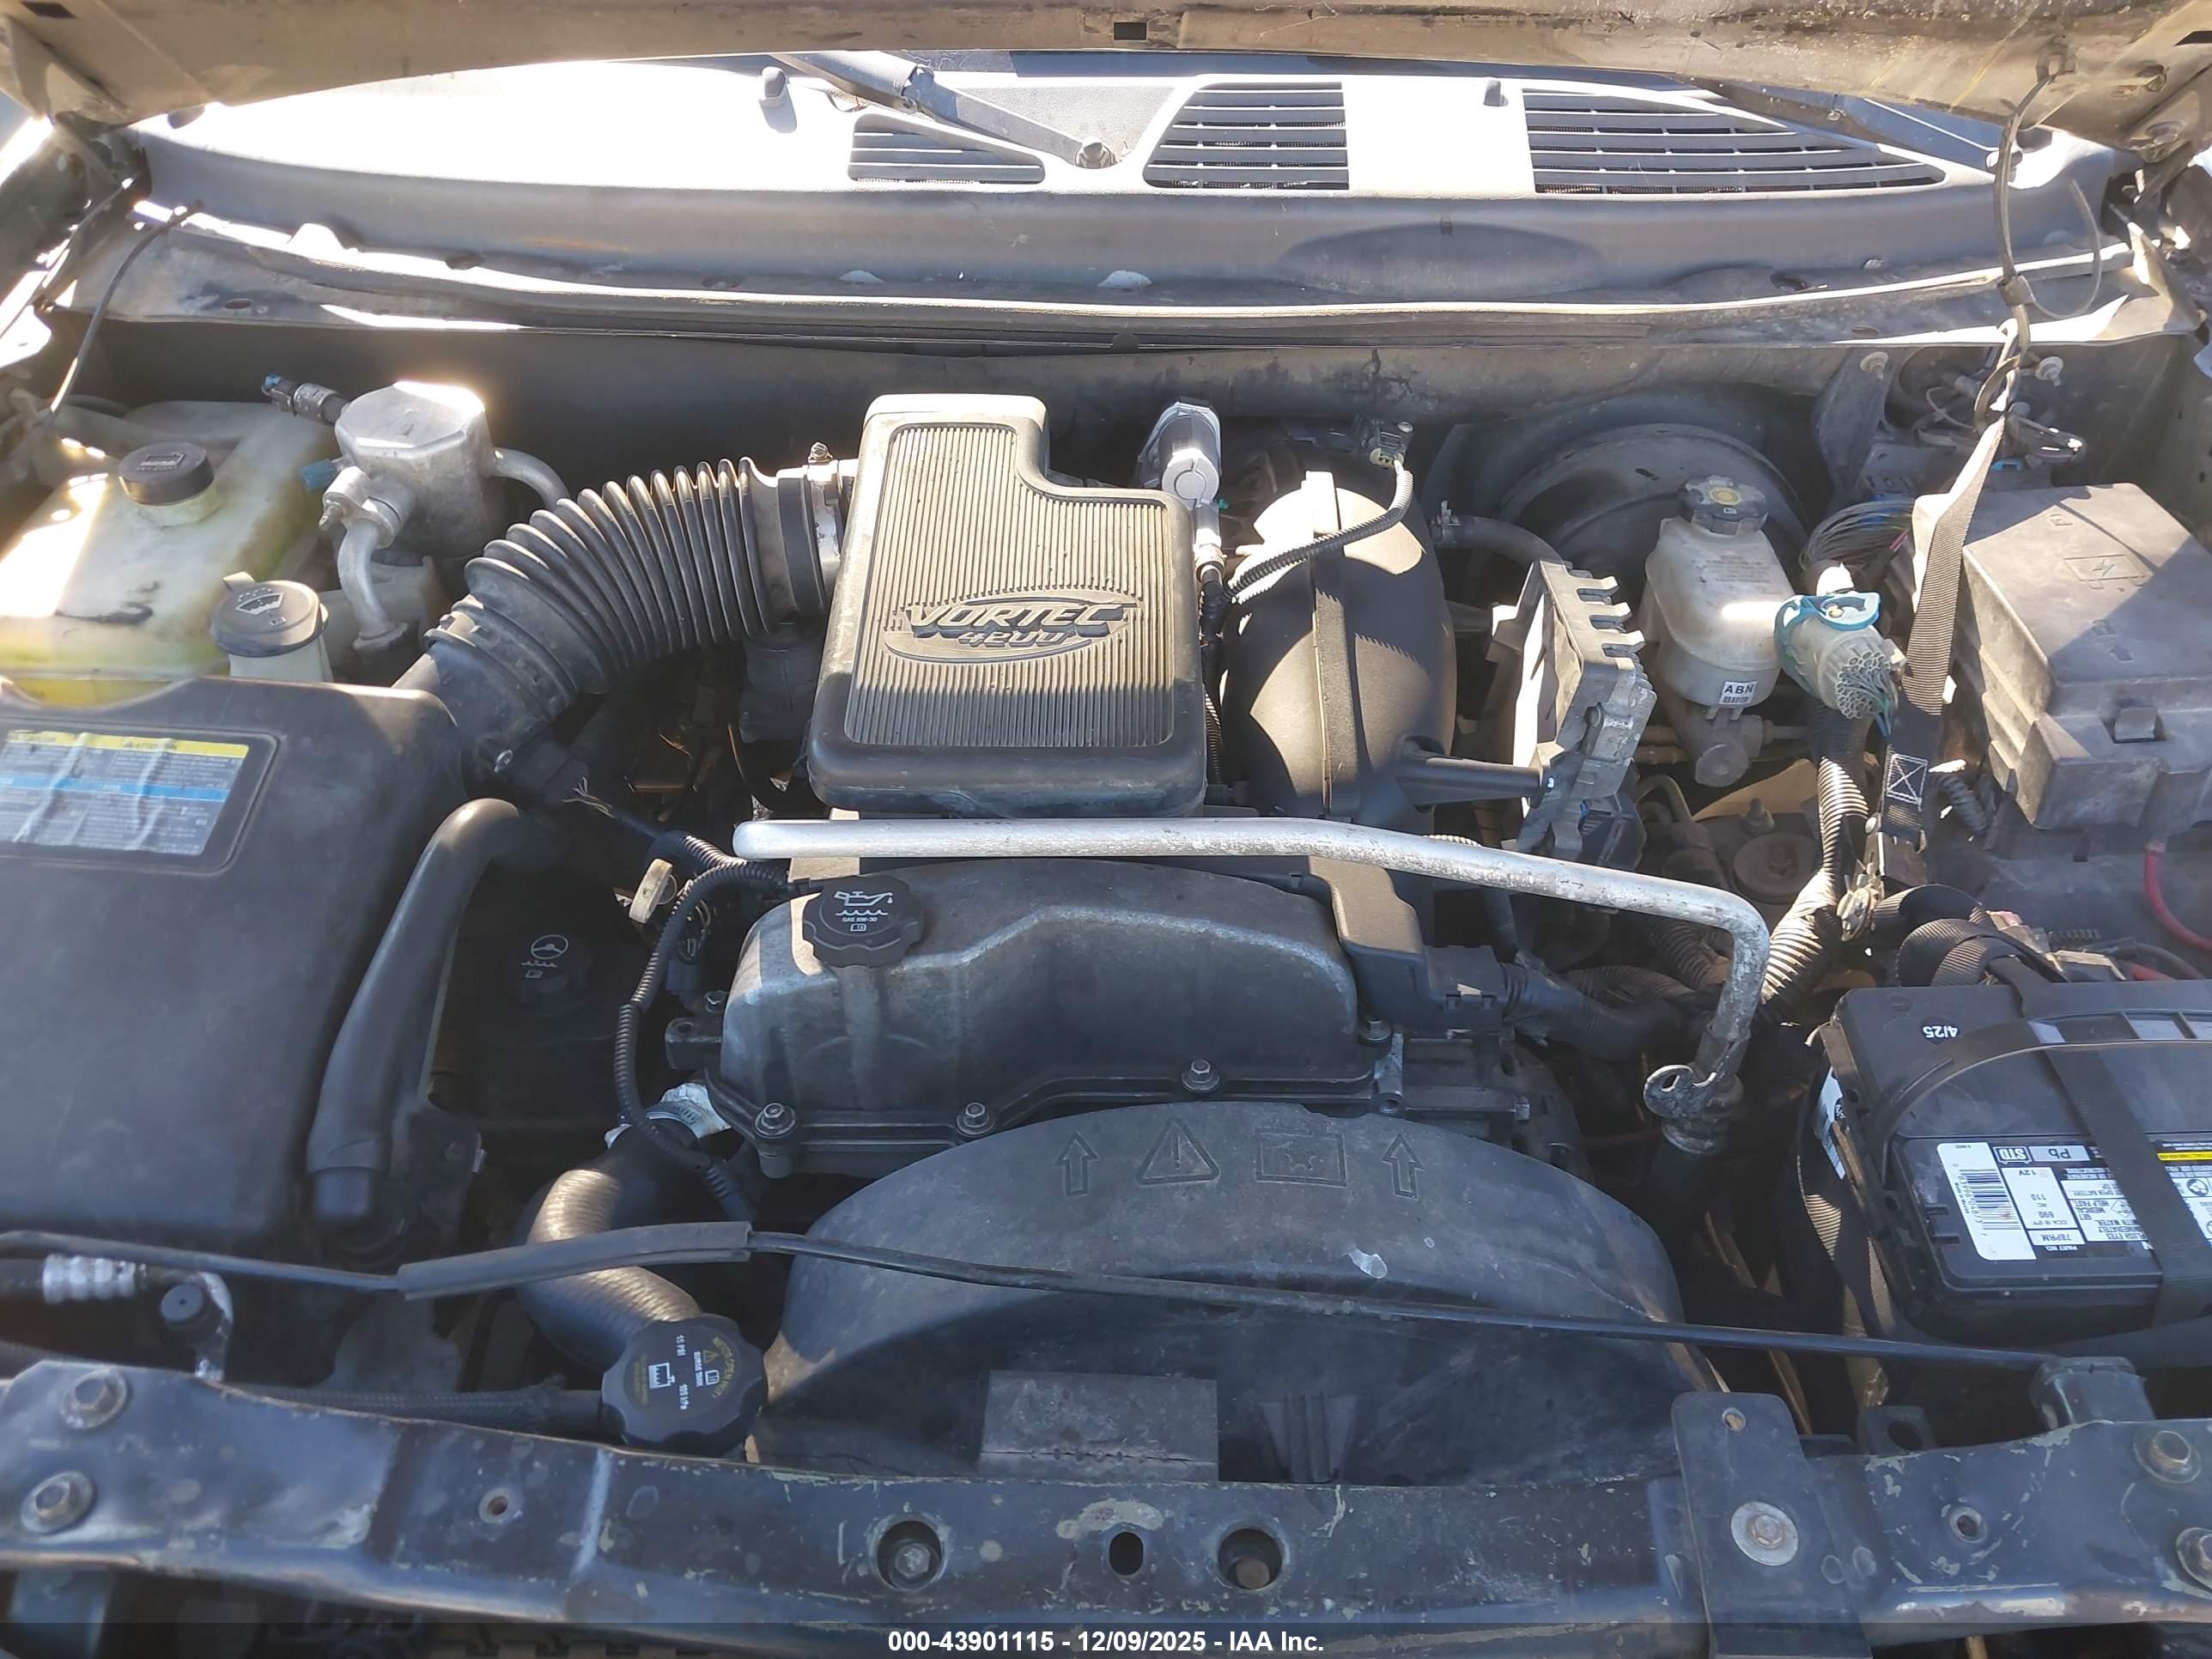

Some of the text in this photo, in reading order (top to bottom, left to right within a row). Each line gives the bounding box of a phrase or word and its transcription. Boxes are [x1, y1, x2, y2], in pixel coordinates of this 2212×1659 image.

[904, 603, 1124, 635] VORTEC
[957, 630, 1068, 647] 4200
[1723, 684, 1754, 694] ABN
[1923, 1025, 1959, 1038] 4/25
[1998, 1148, 2027, 1160] STD
[2048, 1148, 2071, 1159] Pb
[2030, 1193, 2047, 1201] 110
